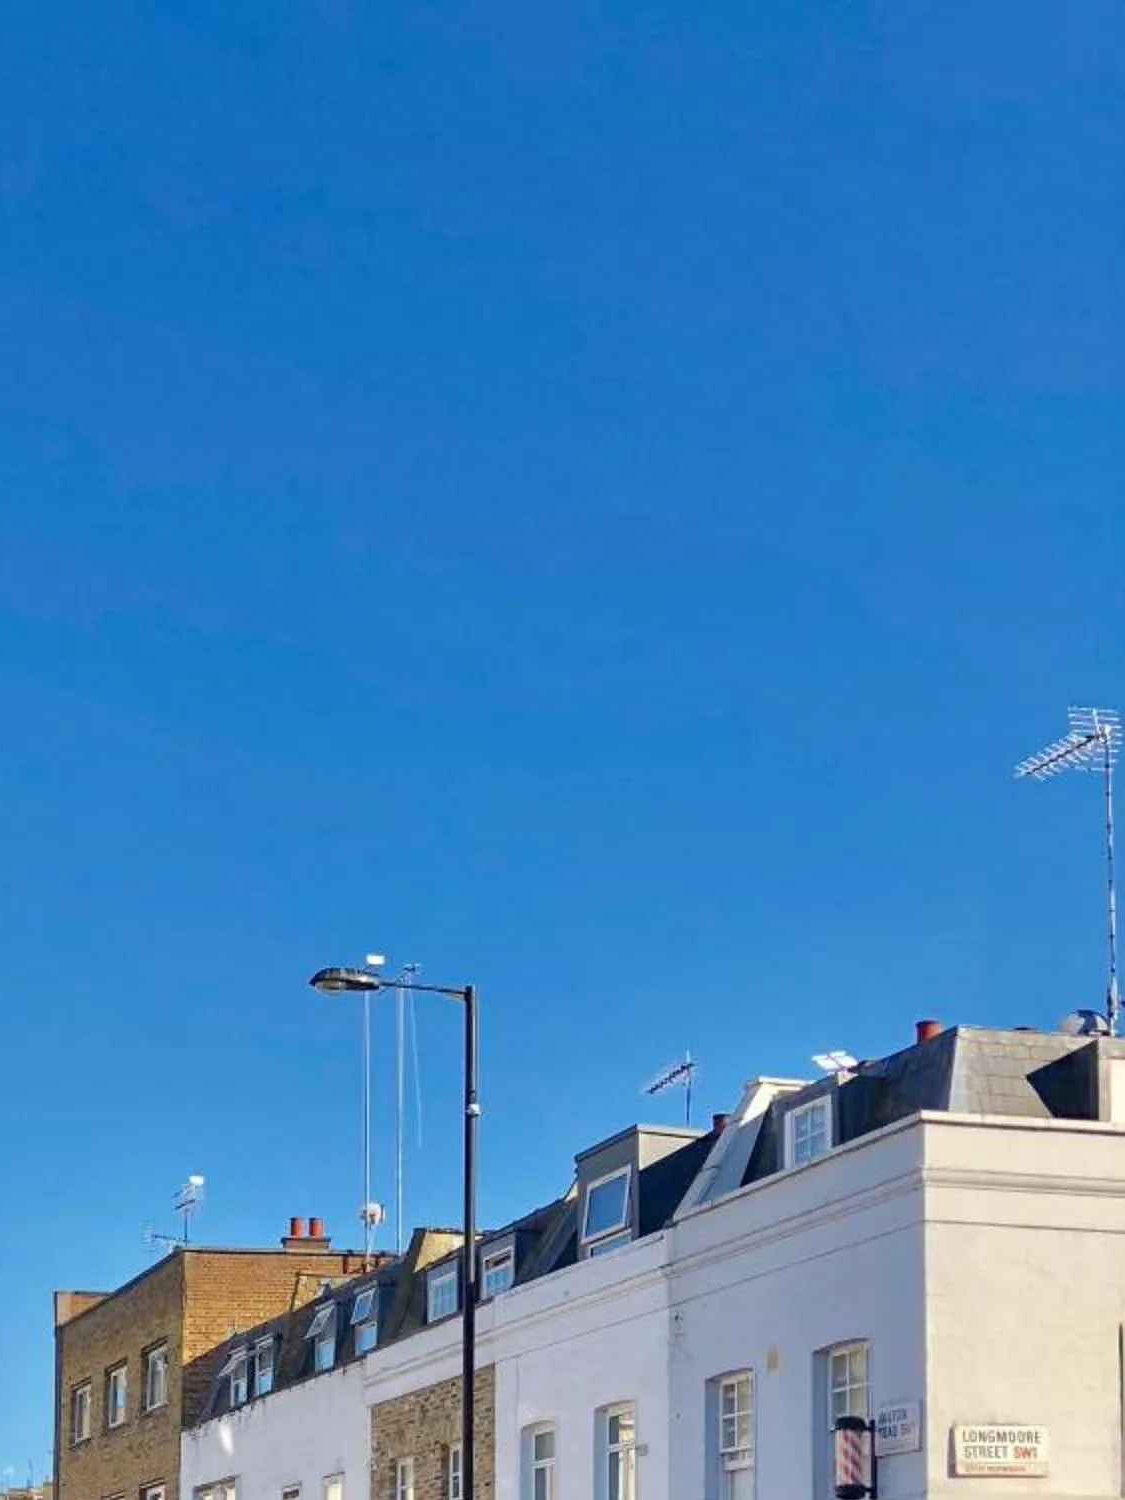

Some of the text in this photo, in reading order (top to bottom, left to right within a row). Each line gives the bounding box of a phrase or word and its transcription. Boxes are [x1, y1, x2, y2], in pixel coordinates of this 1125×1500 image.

[962, 1429, 1042, 1445] LONGMOORE
[964, 1445, 1038, 1459] STREET SW1
